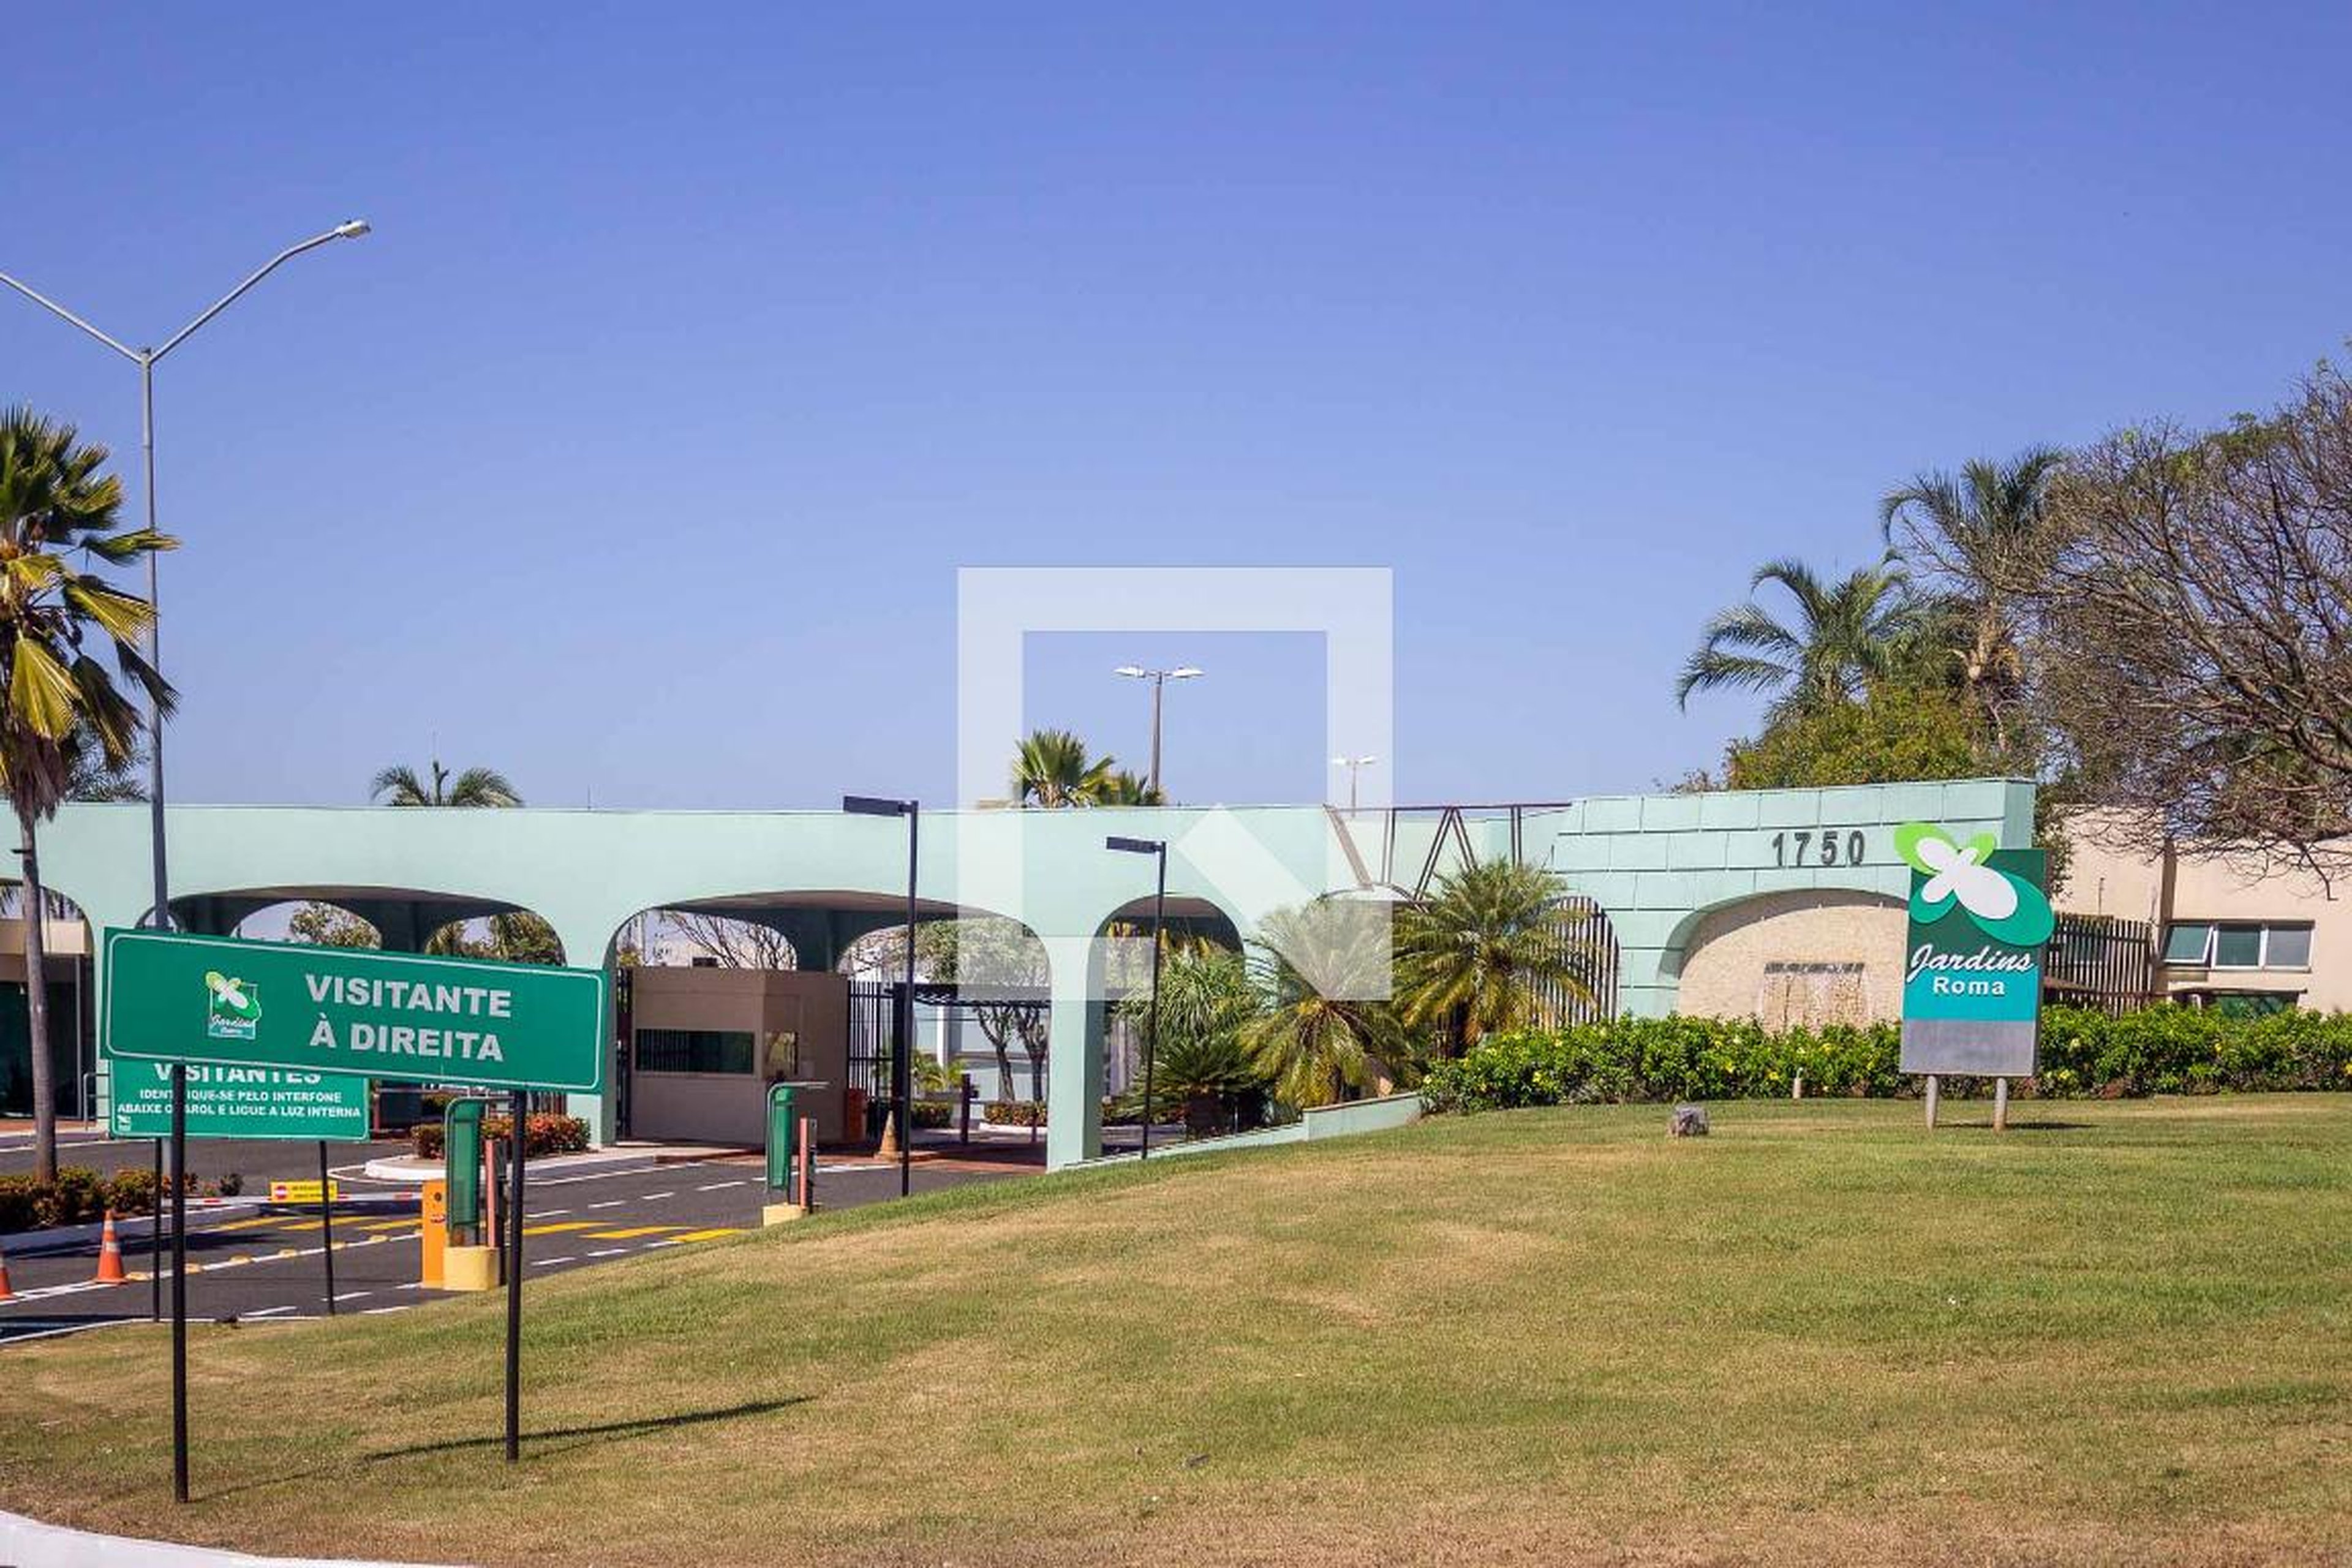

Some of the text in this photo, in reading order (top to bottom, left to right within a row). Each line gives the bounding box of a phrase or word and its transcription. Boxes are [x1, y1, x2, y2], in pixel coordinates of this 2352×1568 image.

[1772, 831, 1864, 866] 1750
[1907, 943, 2035, 983] Jardins
[306, 974, 511, 1017] VISITANTE
[1933, 977, 2005, 995] Roma
[309, 1012, 503, 1061] À DIREITA
[154, 1063, 321, 1084] VSITANTES
[184, 1104, 214, 1115] AROL
[268, 1106, 278, 1115] A
[281, 1106, 305, 1116] LUZ
[307, 1107, 361, 1117] INTERNA
[238, 1091, 268, 1101] PELO
[273, 1091, 342, 1103] INTERFONE
